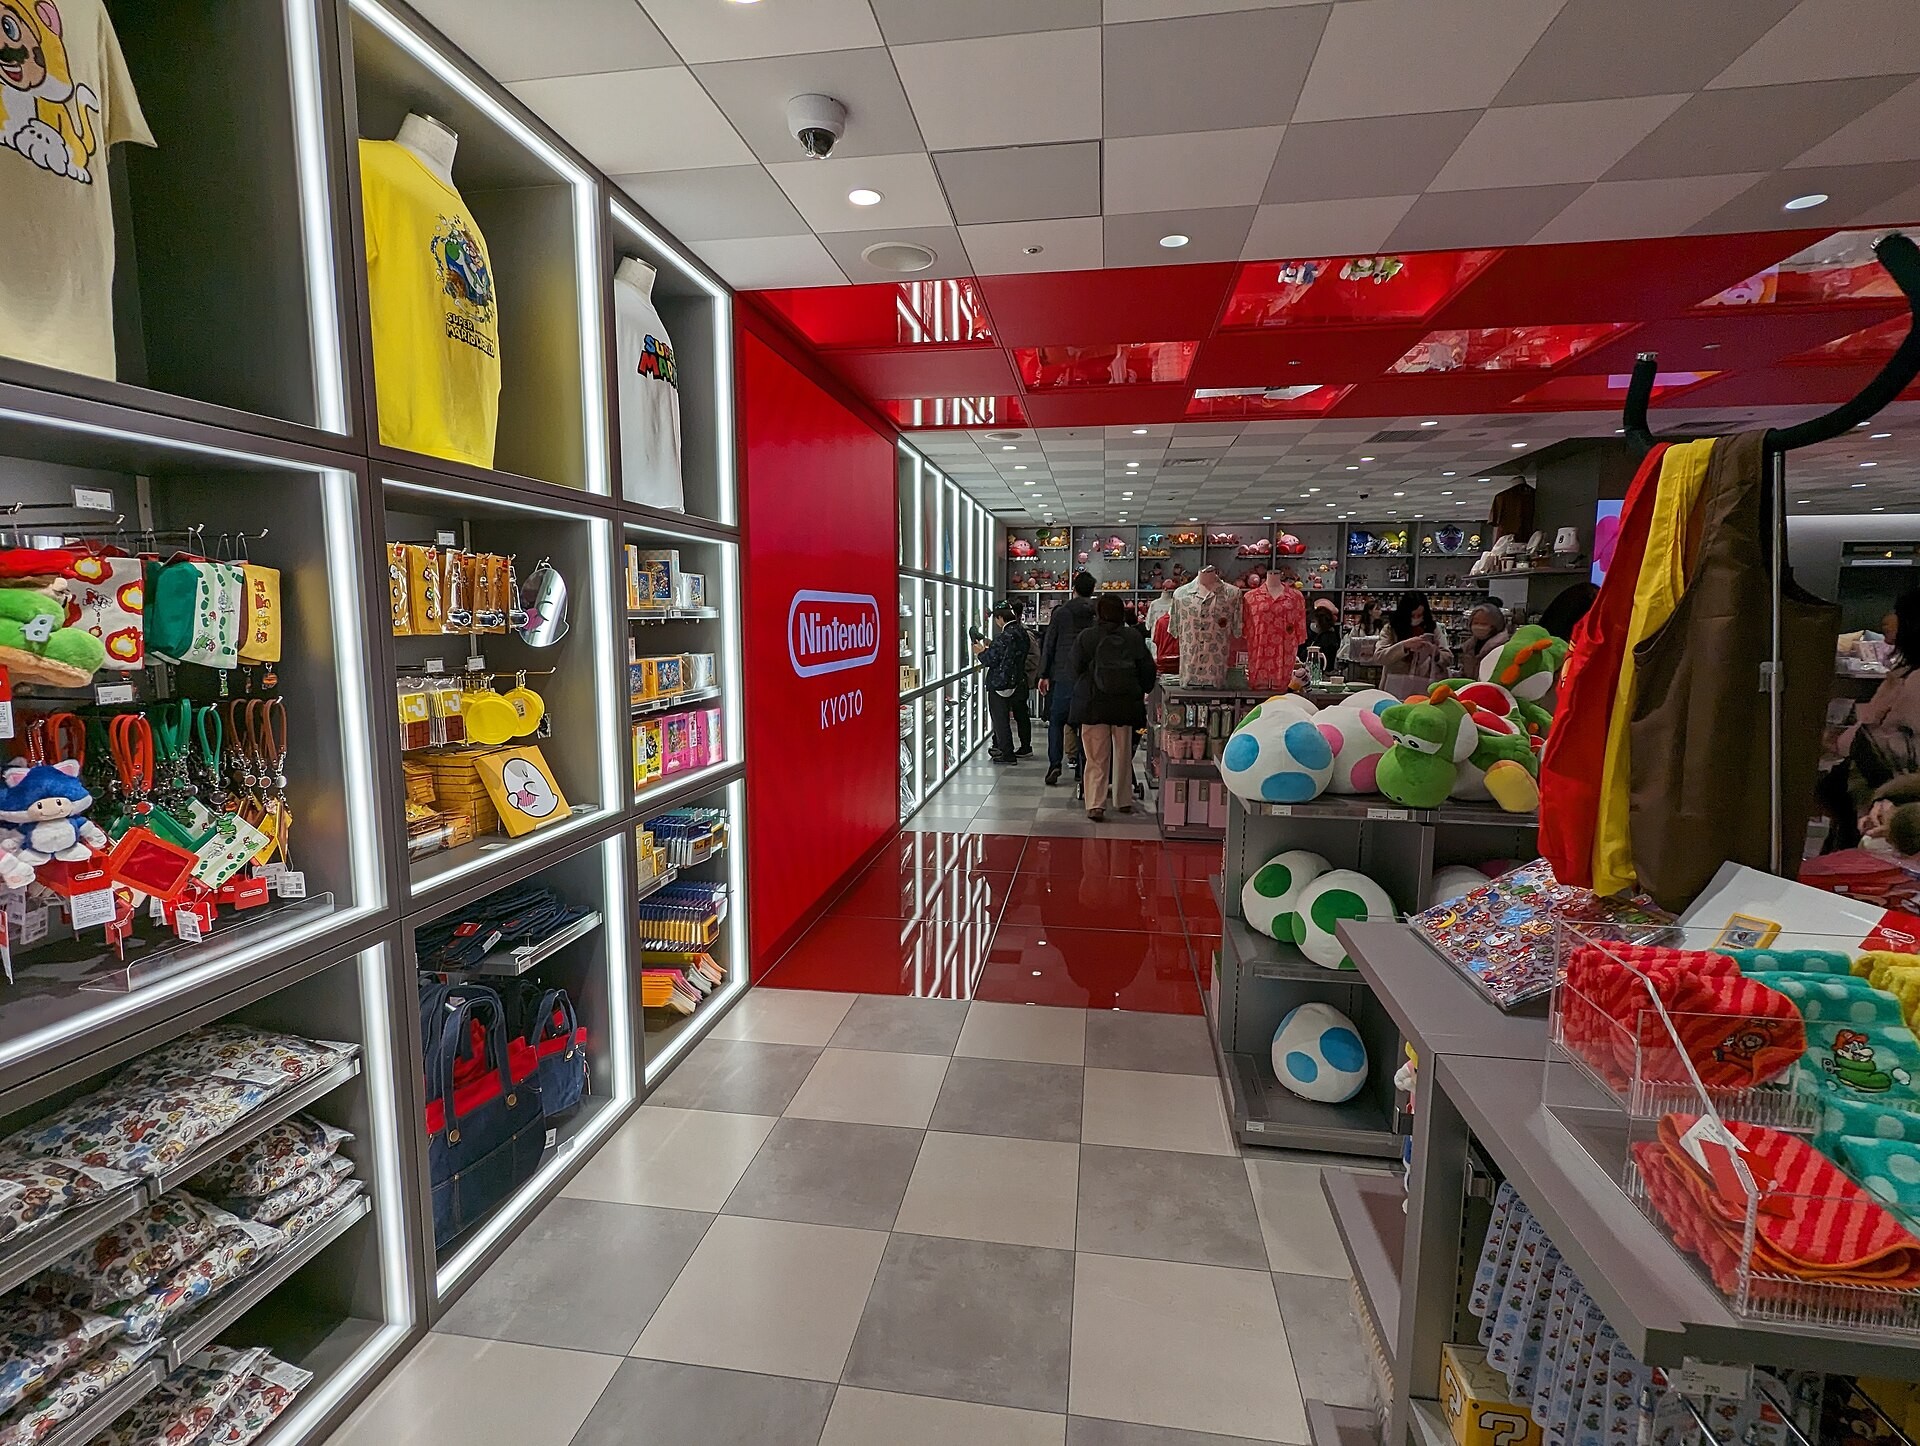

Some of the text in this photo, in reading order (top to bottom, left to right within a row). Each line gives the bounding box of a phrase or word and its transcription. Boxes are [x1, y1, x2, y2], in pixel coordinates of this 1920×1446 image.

[446, 312, 474, 332] SUPER
[446, 323, 476, 347] MARIO
[799, 612, 874, 656] Nintendo
[820, 688, 863, 730] KYOTO
